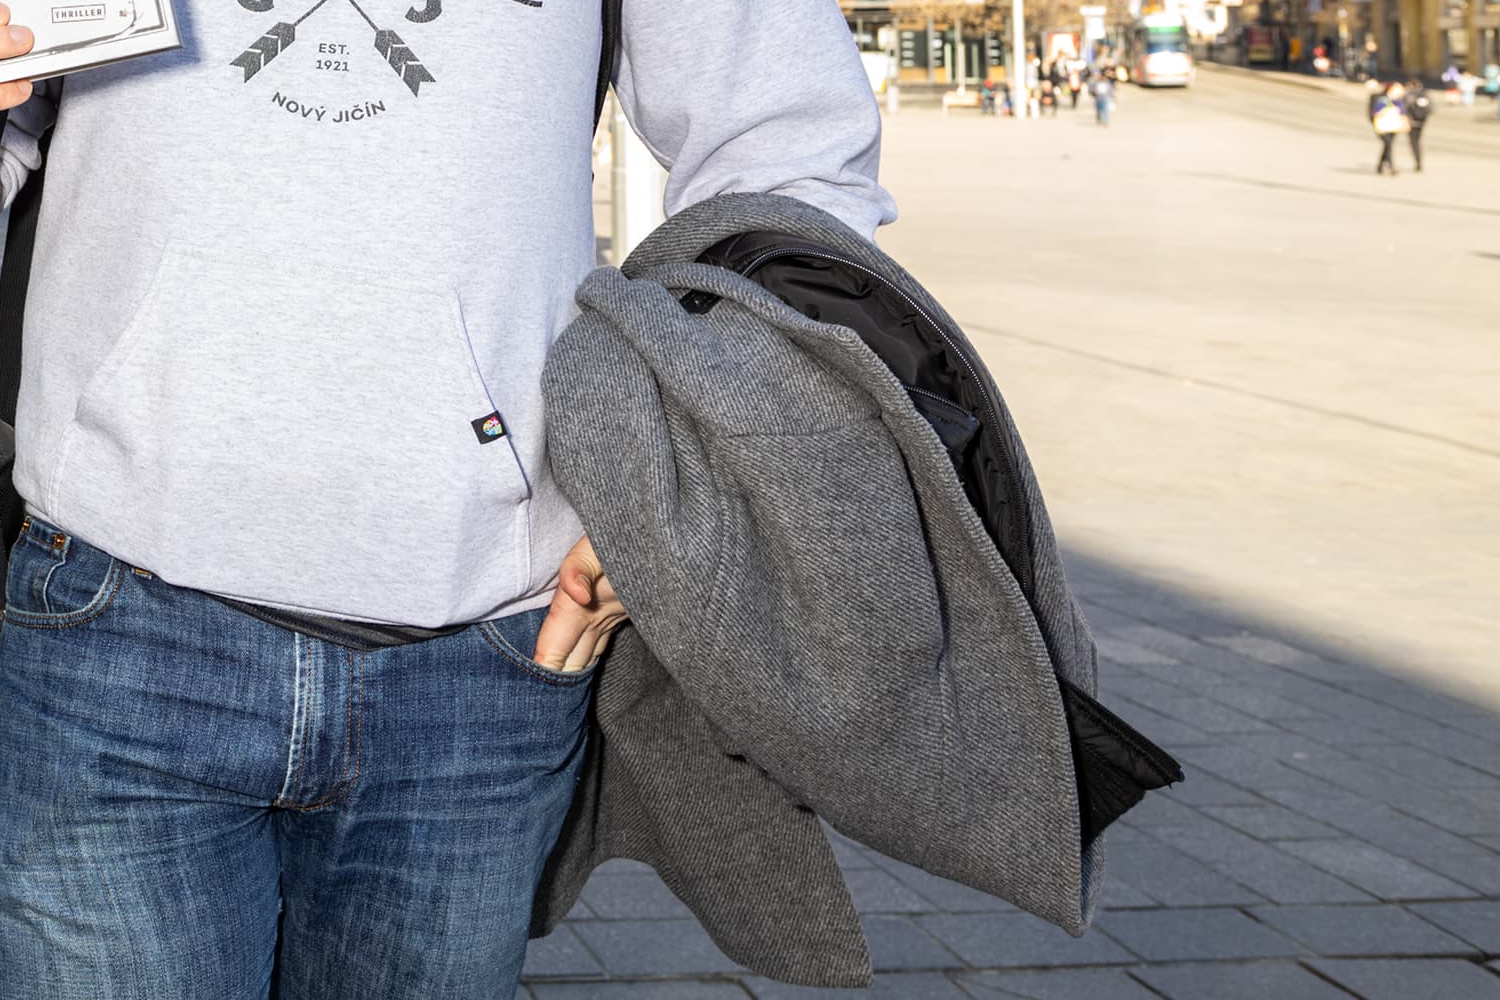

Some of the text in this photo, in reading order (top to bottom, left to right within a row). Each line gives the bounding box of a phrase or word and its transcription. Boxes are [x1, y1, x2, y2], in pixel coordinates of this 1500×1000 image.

[54, 8, 103, 20] THRILLER
[318, 43, 351, 56] EST.
[315, 59, 350, 73] 1921
[271, 91, 386, 124] NOVÝ JIČÍN
